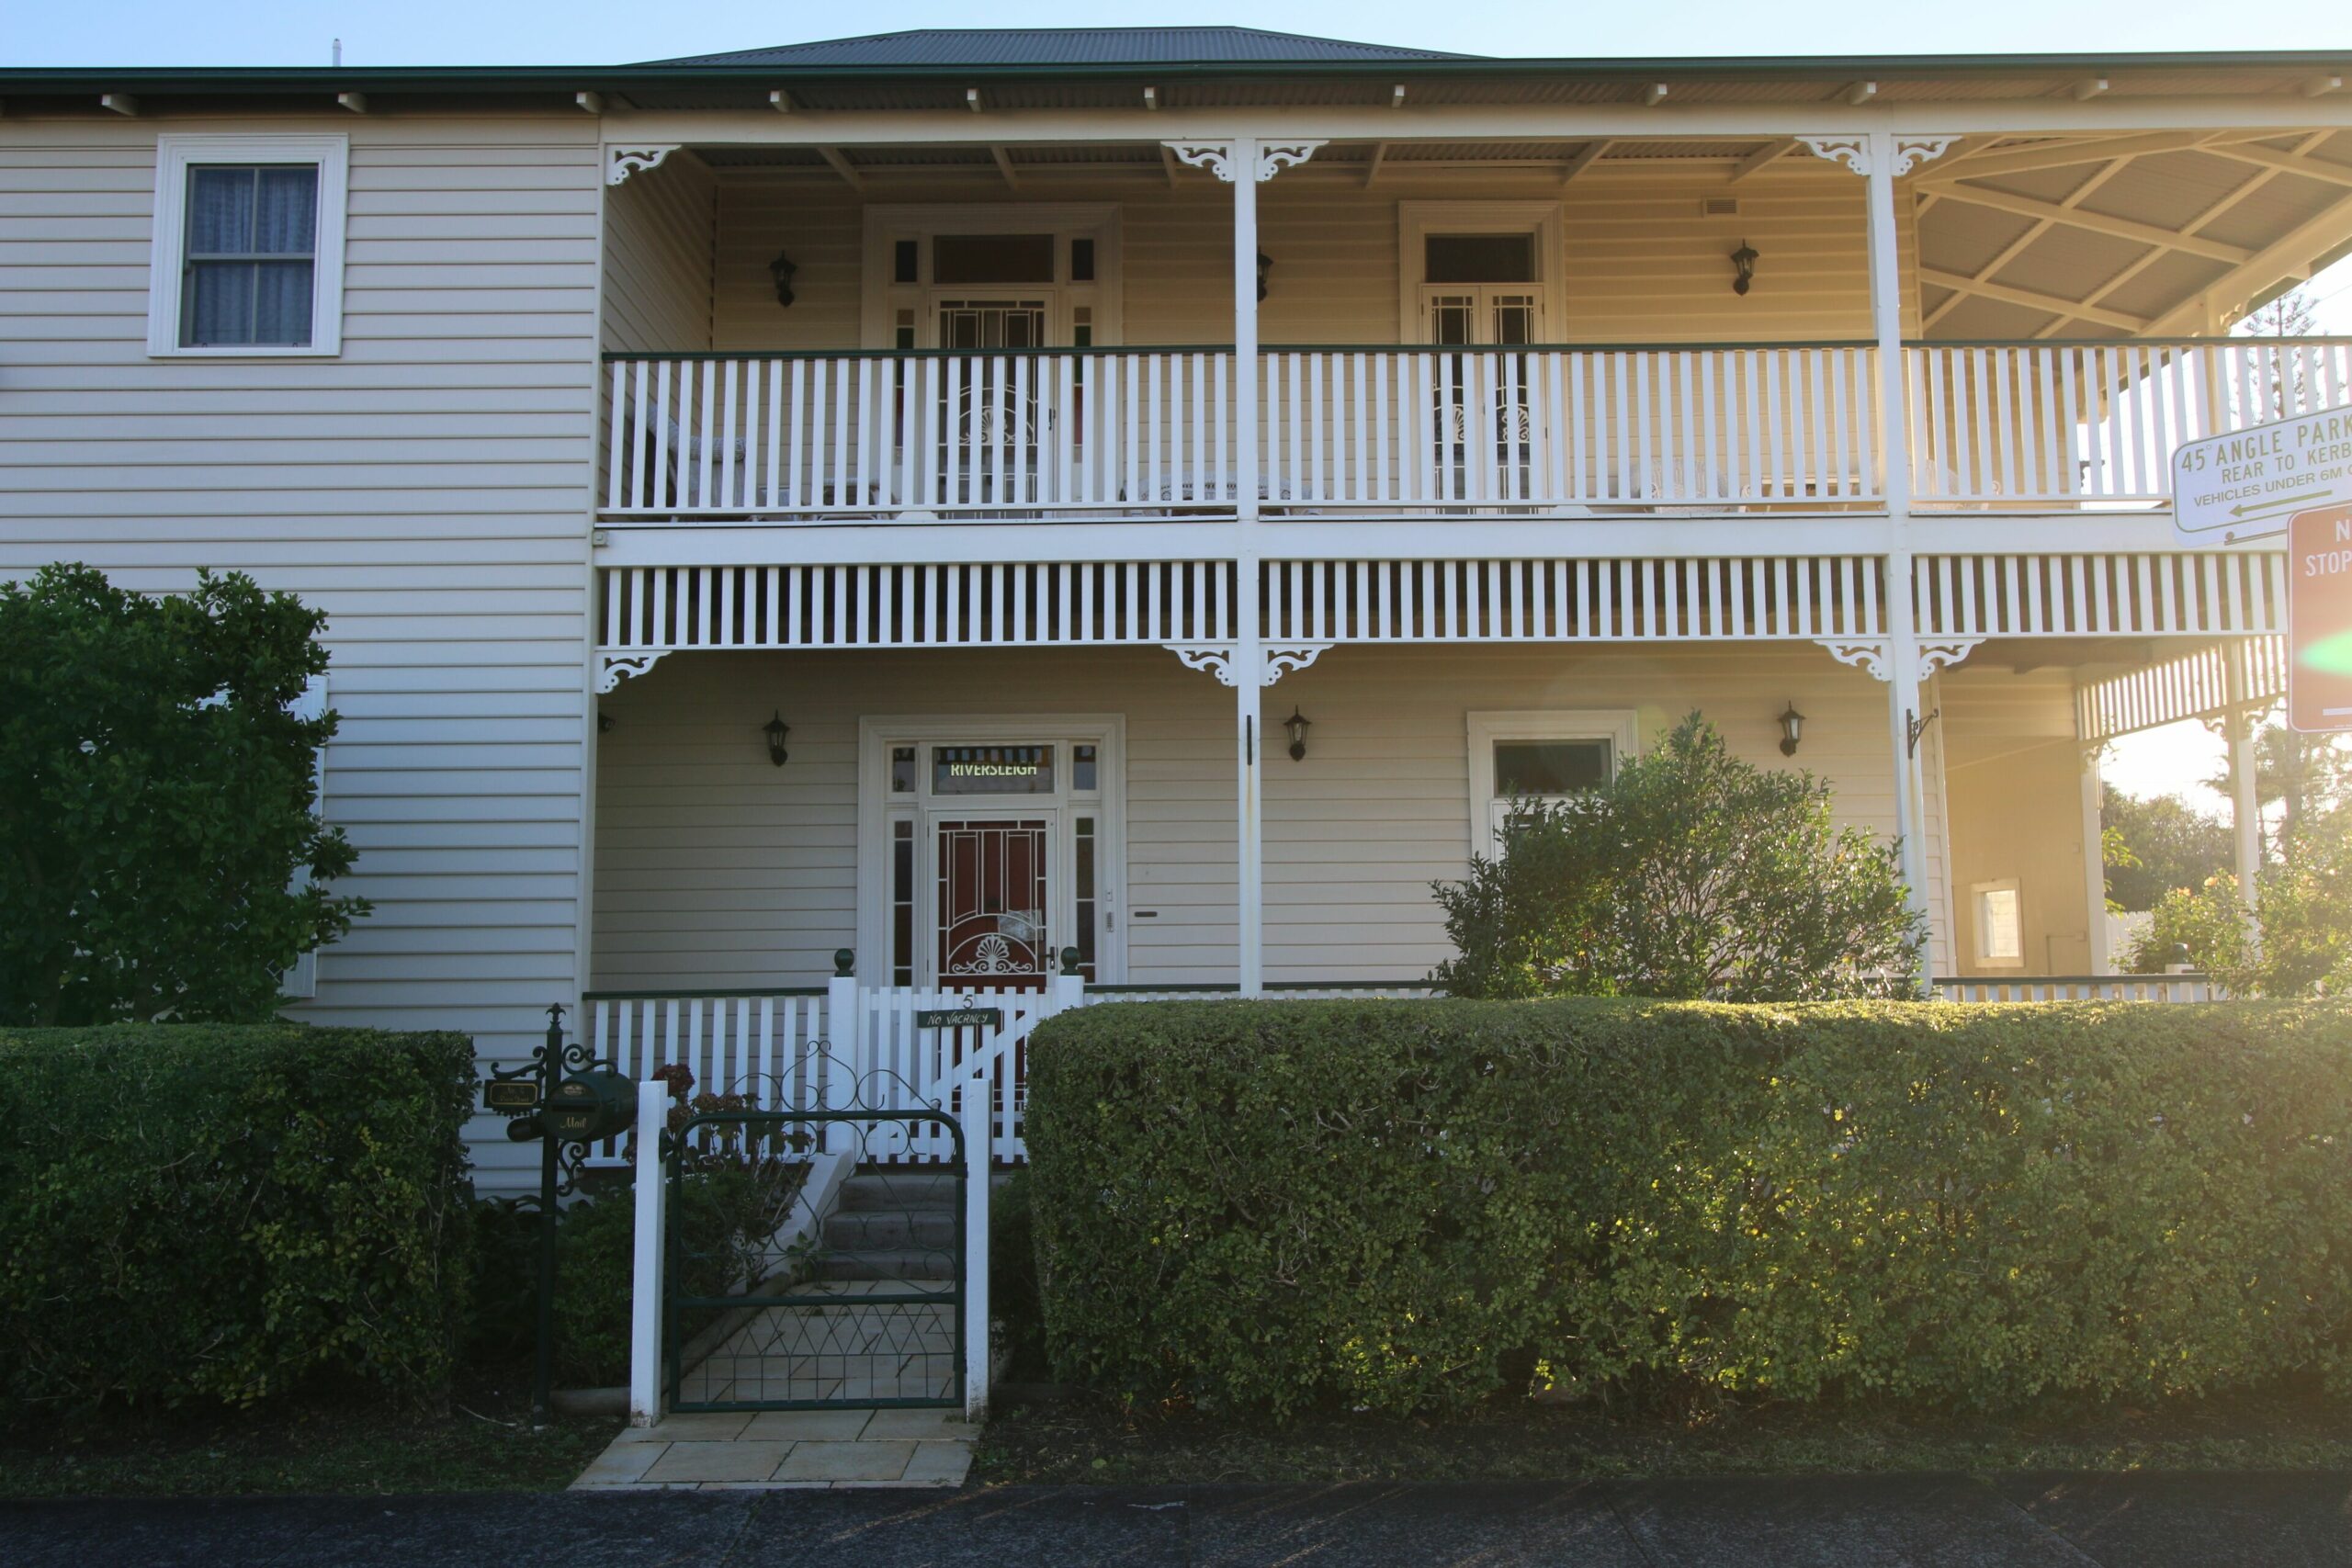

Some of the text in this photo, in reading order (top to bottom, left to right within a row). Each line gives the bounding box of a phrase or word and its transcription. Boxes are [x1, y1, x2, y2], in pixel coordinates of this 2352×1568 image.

[2216, 431, 2283, 466] ANGLE
[2222, 442, 2352, 484] REAR TO KERB
[2194, 485, 2261, 507] VEHICLES
[2266, 472, 2315, 492] UNDER
[2320, 467, 2342, 480] 6M
[2305, 550, 2352, 577] STOP
[950, 762, 1037, 776] RIVERSLEIGH
[963, 994, 974, 1009] 5
[927, 1011, 989, 1025] NO VACANCY
[560, 1116, 587, 1129] Mail
